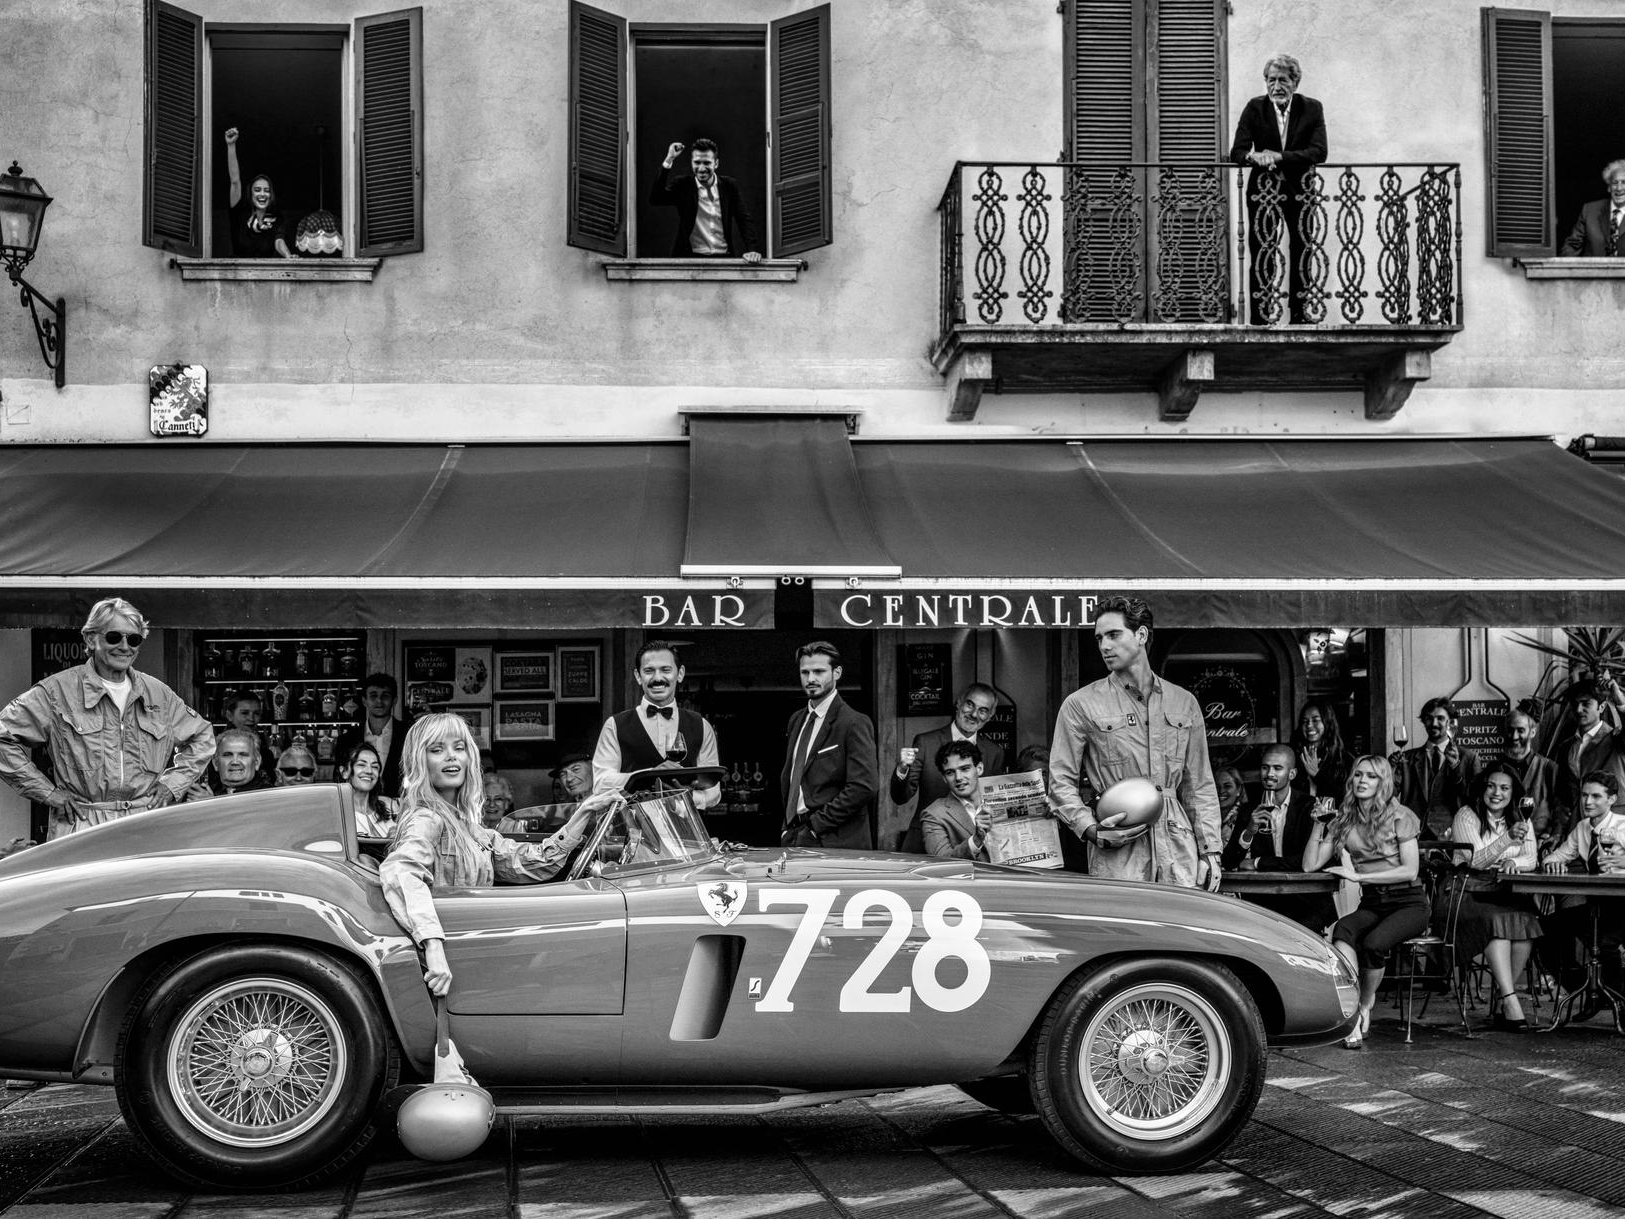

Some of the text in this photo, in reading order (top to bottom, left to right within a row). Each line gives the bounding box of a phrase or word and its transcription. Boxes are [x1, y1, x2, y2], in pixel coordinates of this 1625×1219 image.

[642, 595, 1098, 627] BAR CENTRALE
[43, 642, 87, 663] LIQUOR
[916, 652, 934, 660] GIN
[1205, 702, 1242, 720] Bar
[1206, 722, 1249, 737] ntrale
[1462, 726, 1498, 735] SPRITZ
[1456, 736, 1505, 746] TOSCANO
[1009, 853, 1045, 865] BROOKLYN
[755, 889, 992, 1012] 728
